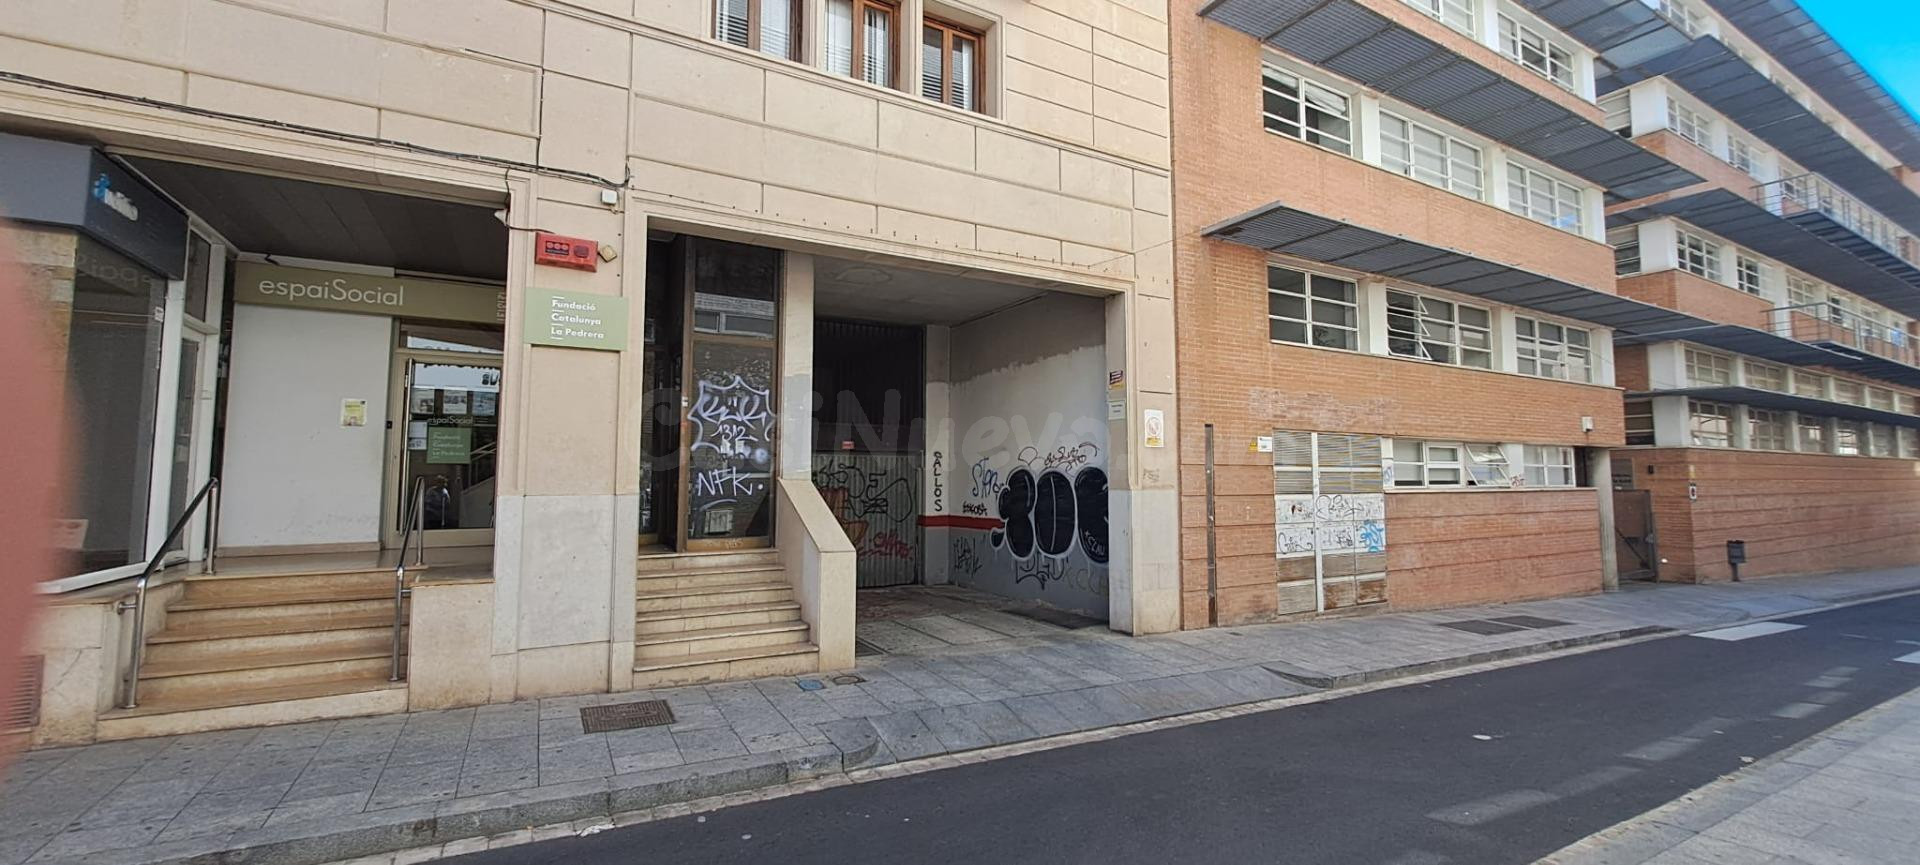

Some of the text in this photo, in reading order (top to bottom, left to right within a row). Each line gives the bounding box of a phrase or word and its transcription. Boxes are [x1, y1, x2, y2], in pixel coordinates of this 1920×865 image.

[259, 278, 405, 308] espaiSocial
[552, 299, 597, 311] Fundació
[551, 312, 602, 326] Catalunya
[551, 327, 605, 340] La Pedrera
